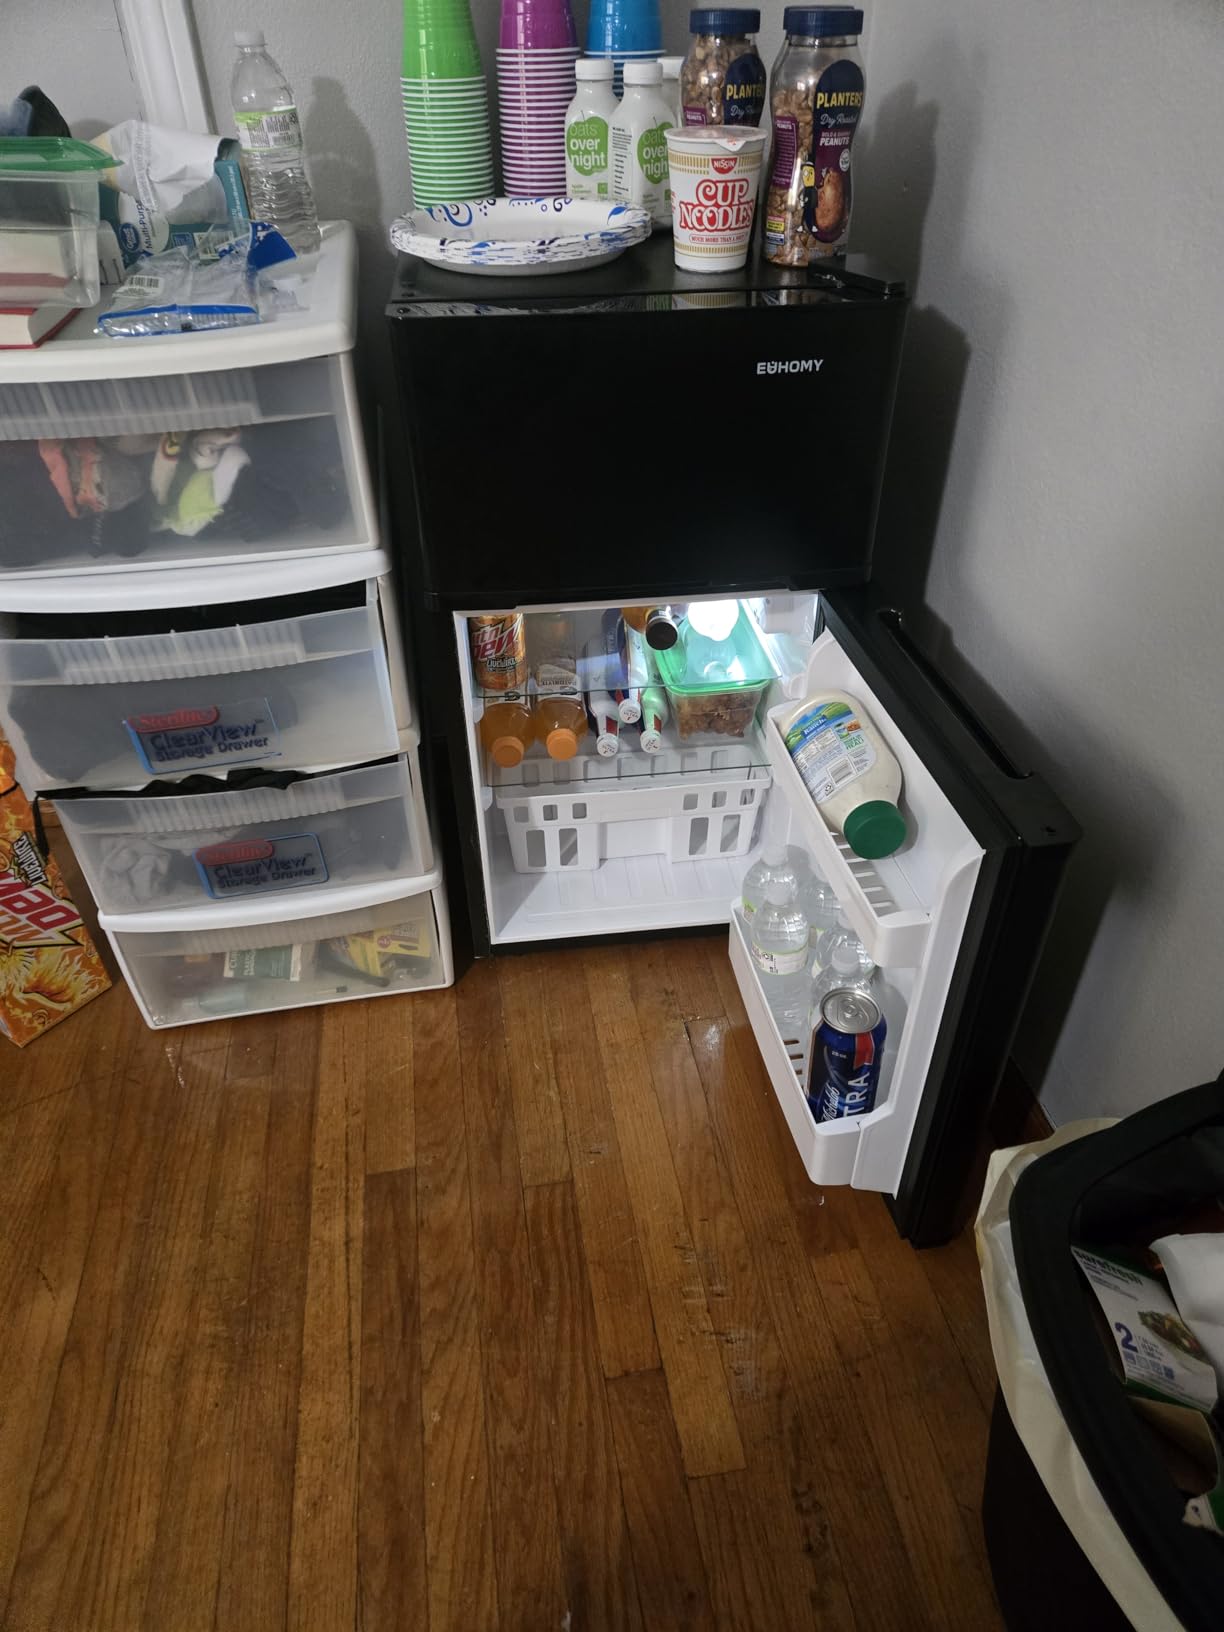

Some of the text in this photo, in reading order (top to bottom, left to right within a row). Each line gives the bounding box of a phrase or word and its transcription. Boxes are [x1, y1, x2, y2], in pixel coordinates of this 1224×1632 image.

[726, 84, 765, 100] PLANTE
[816, 91, 863, 109] PLANTERS
[820, 113, 837, 128] Dry
[570, 138, 600, 151] over
[820, 137, 849, 146] PEANUTS
[571, 151, 606, 170] night
[643, 159, 669, 178] nigh
[713, 160, 736, 168] NISSIN
[696, 178, 749, 207] CUP
[680, 200, 755, 232] NOODLES
[756, 359, 824, 375] EUHOMY
[150, 721, 257, 750] ClearView
[218, 736, 268, 754] Drawer
[271, 866, 316, 881] Drawer
[844, 1072, 869, 1116] TRA
[1114, 1321, 1139, 1354] 2
